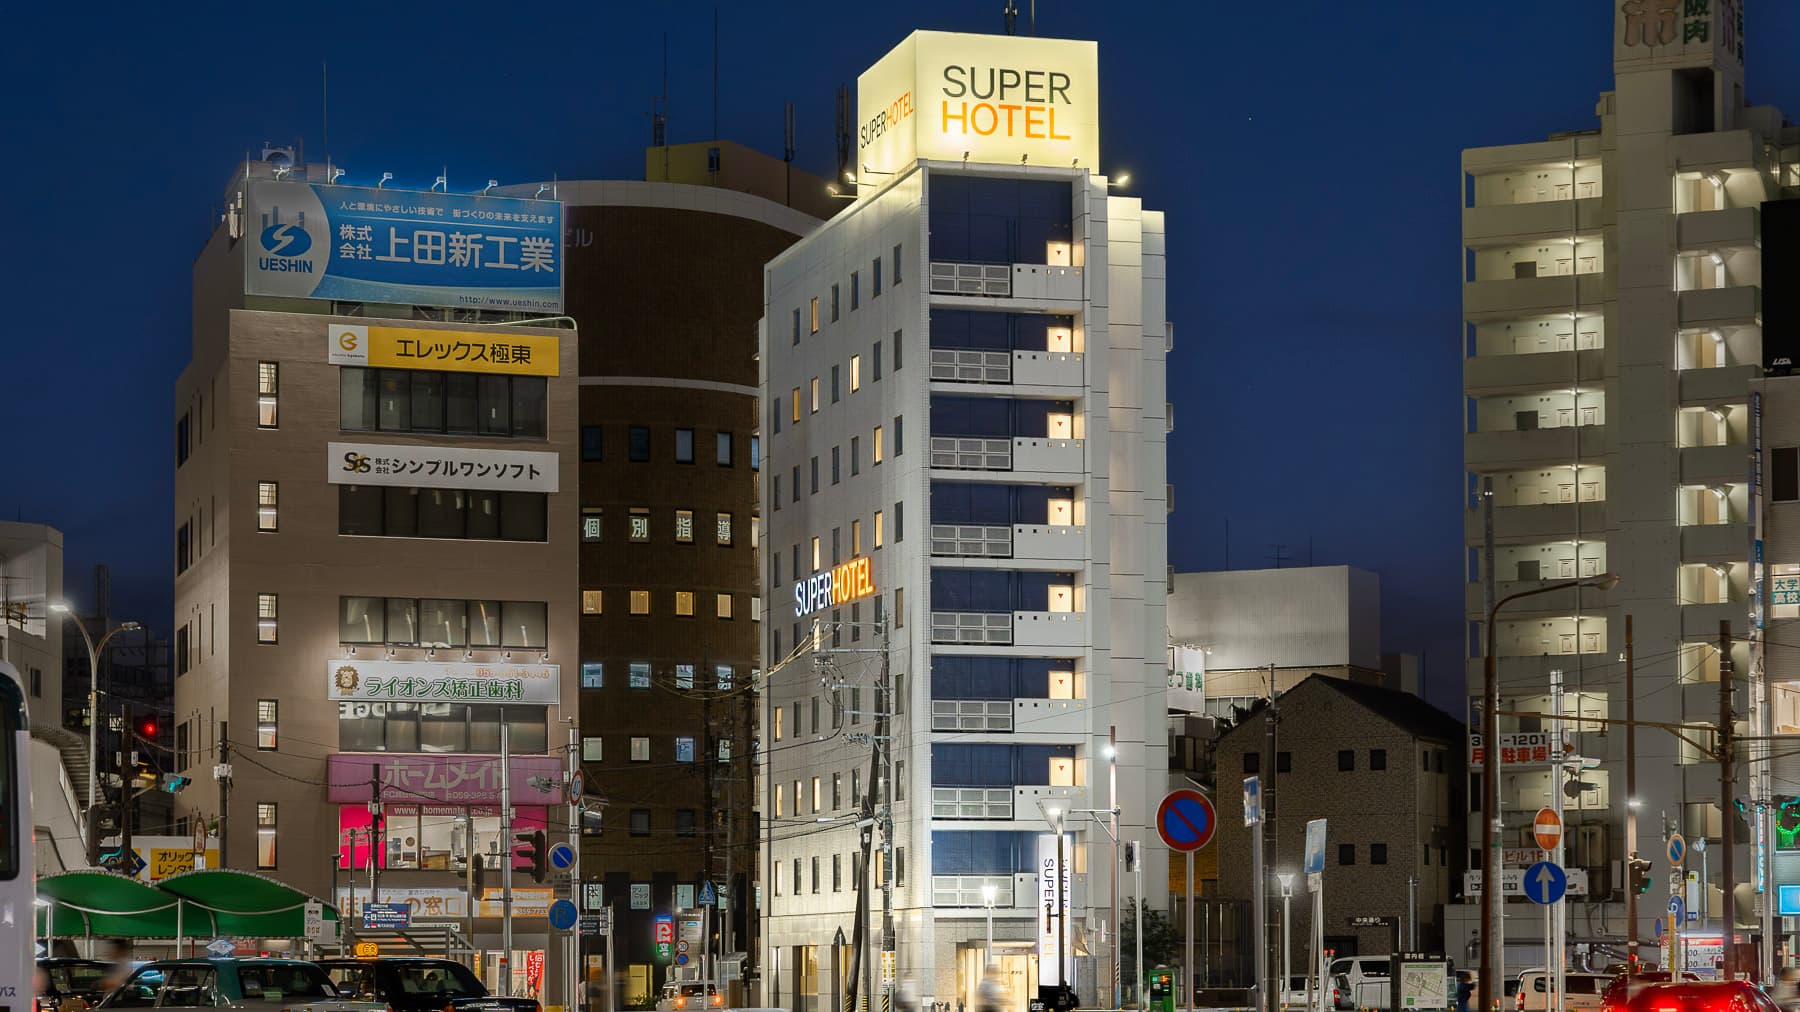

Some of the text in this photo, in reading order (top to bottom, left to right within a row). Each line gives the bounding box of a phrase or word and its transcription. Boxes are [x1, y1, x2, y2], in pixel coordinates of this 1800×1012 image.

[942, 65, 1071, 104] SUPER
[860, 91, 914, 149] SUPERHOTEL
[942, 100, 1071, 141] HOTEL
[339, 201, 554, 224] 人と環境にやさしい技術で 街づくりの未来を支えます
[340, 224, 372, 241] 株式
[340, 243, 372, 260] 会社
[375, 226, 555, 273] 上田新工業
[259, 257, 313, 273] UESHIN
[460, 295, 559, 308] http://www.ueshin.com
[396, 339, 531, 364] エレックス極東
[392, 458, 541, 480] シンプルワンソフト
[795, 557, 875, 617] SUPERHOTEL
[364, 678, 524, 701] ライオンズ矯正歯科
[1472, 735, 1546, 746] 3-1201
[1472, 746, 1546, 765] 月駐車場
[384, 759, 502, 790] ホームメイト
[158, 851, 203, 862] オリック
[1044, 858, 1055, 908] SUPER
